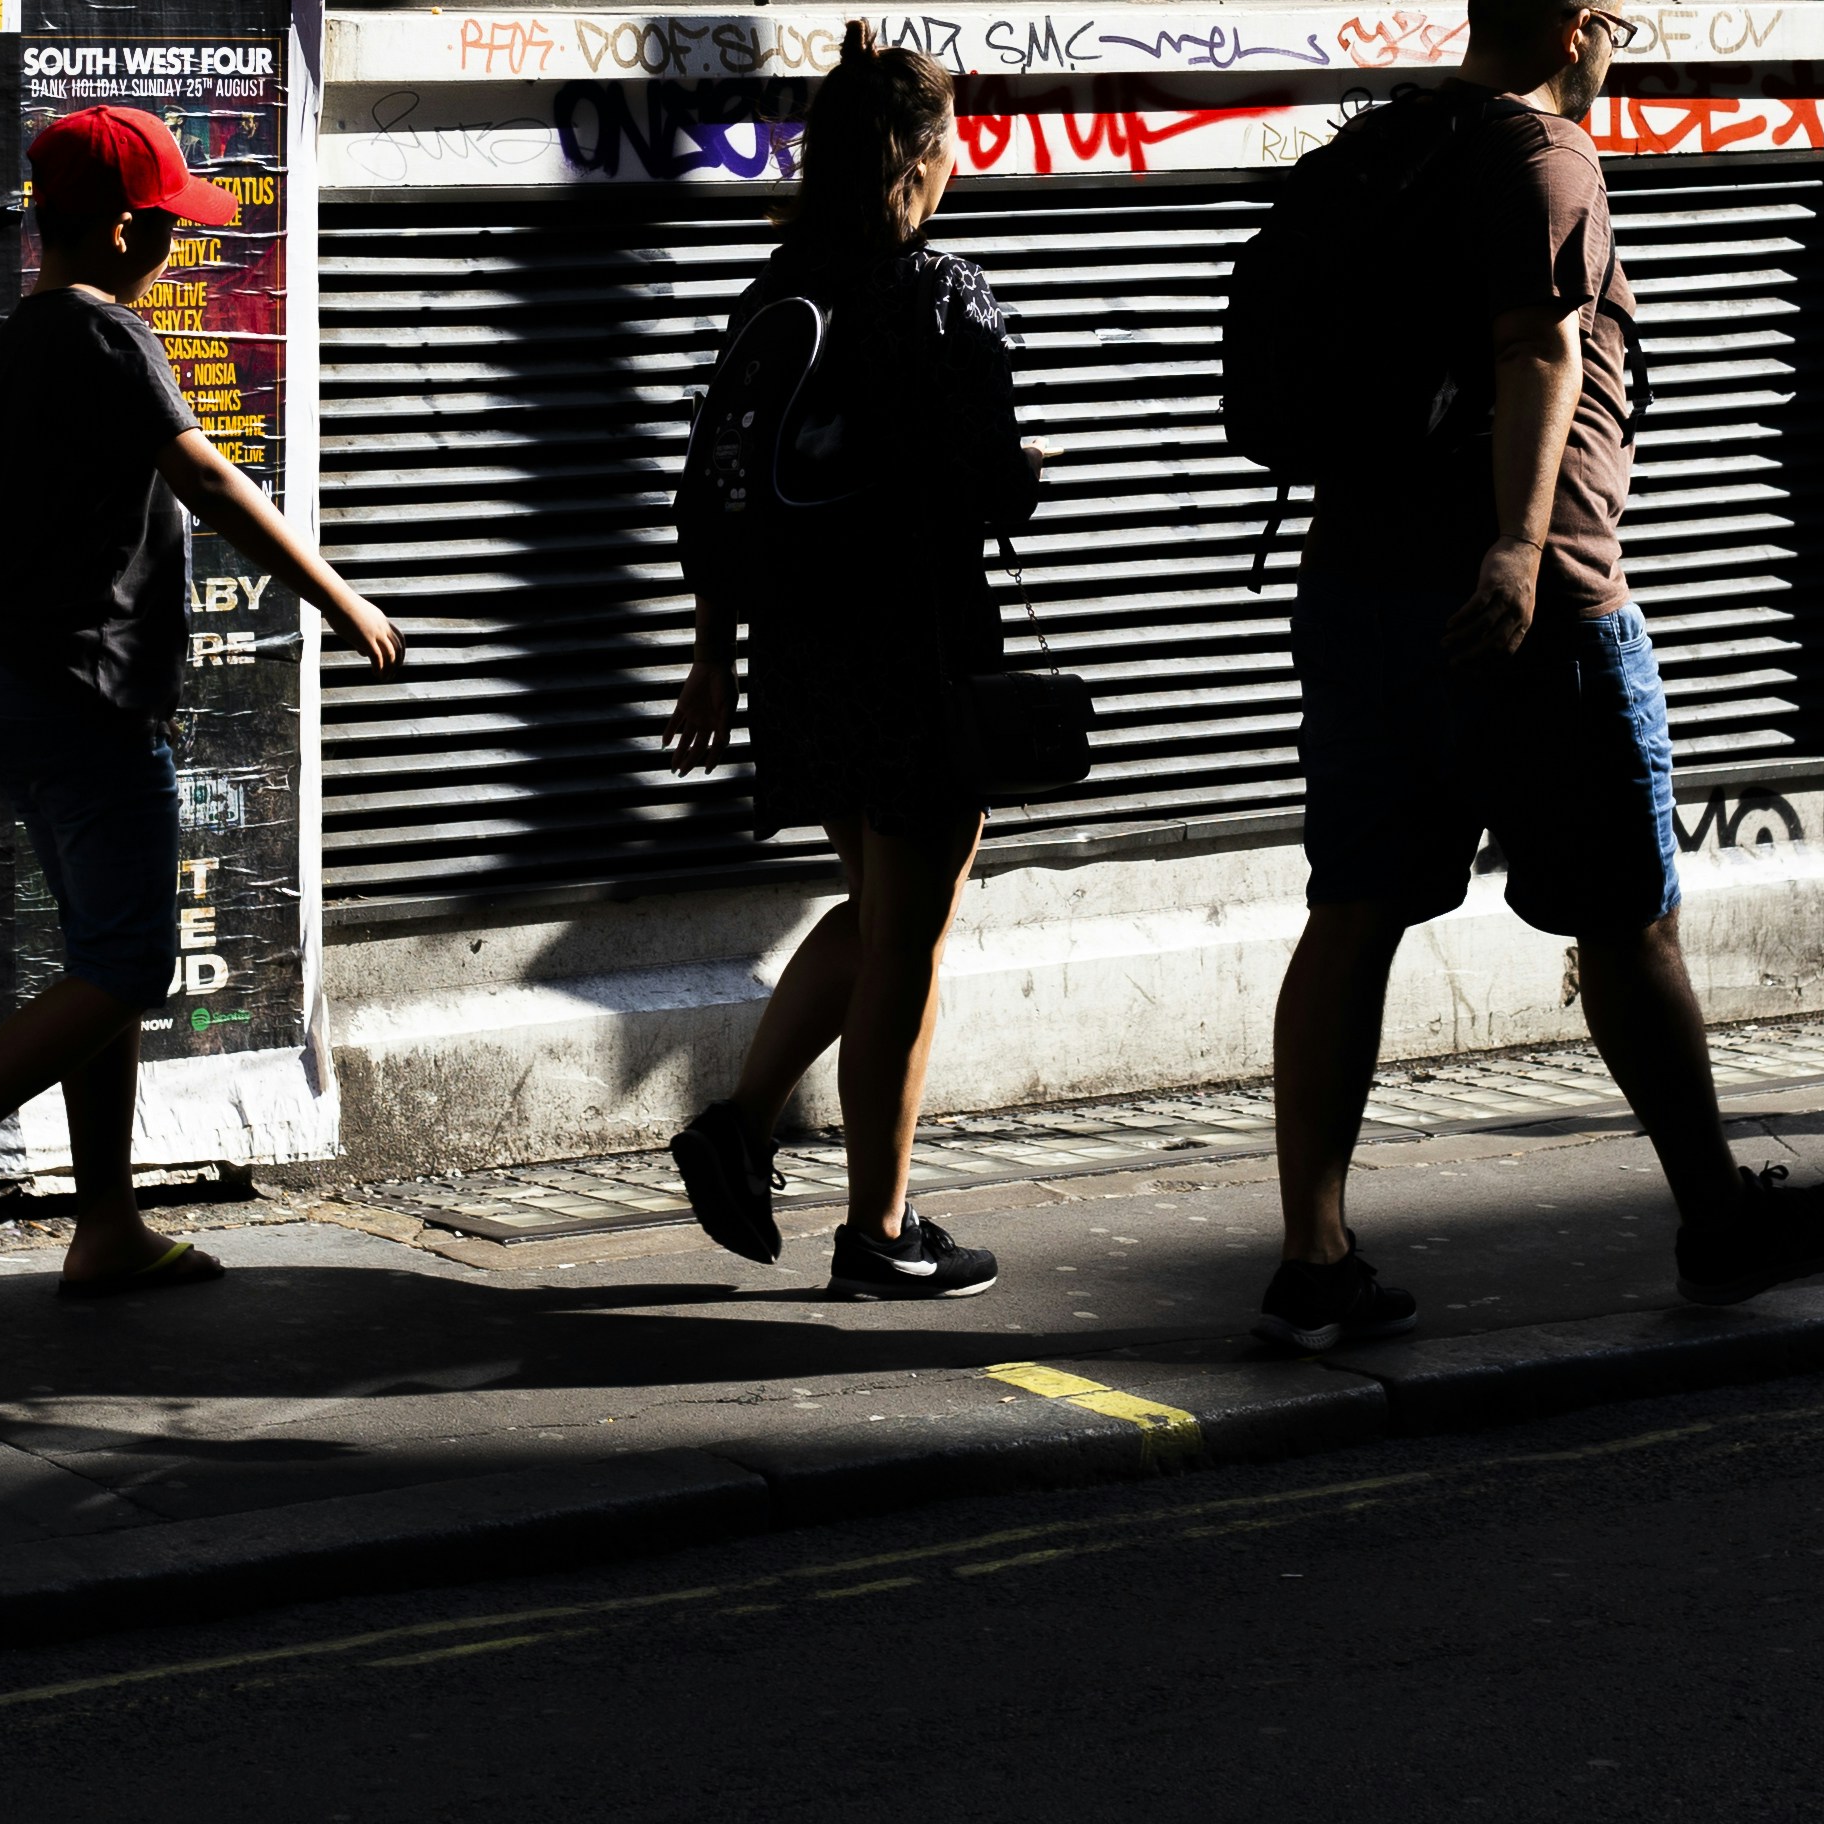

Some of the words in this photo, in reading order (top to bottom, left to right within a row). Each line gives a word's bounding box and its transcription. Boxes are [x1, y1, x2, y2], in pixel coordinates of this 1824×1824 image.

[23, 47, 117, 77] SOUTH
[122, 46, 196, 76] WEST
[200, 46, 274, 76] FOUR
[31, 78, 68, 99] BANK
[71, 78, 127, 98] HOLIDAY
[130, 78, 184, 98] SUNDAY
[215, 77, 266, 98] AUGUST
[176, 281, 208, 308] LIVE
[152, 309, 180, 333] SHY
[194, 362, 237, 387] NOISIA
[197, 389, 241, 413] BANKS
[221, 414, 266, 438] EMPIRE
[244, 446, 265, 463] LIVE
[141, 1017, 174, 1032] NOW
